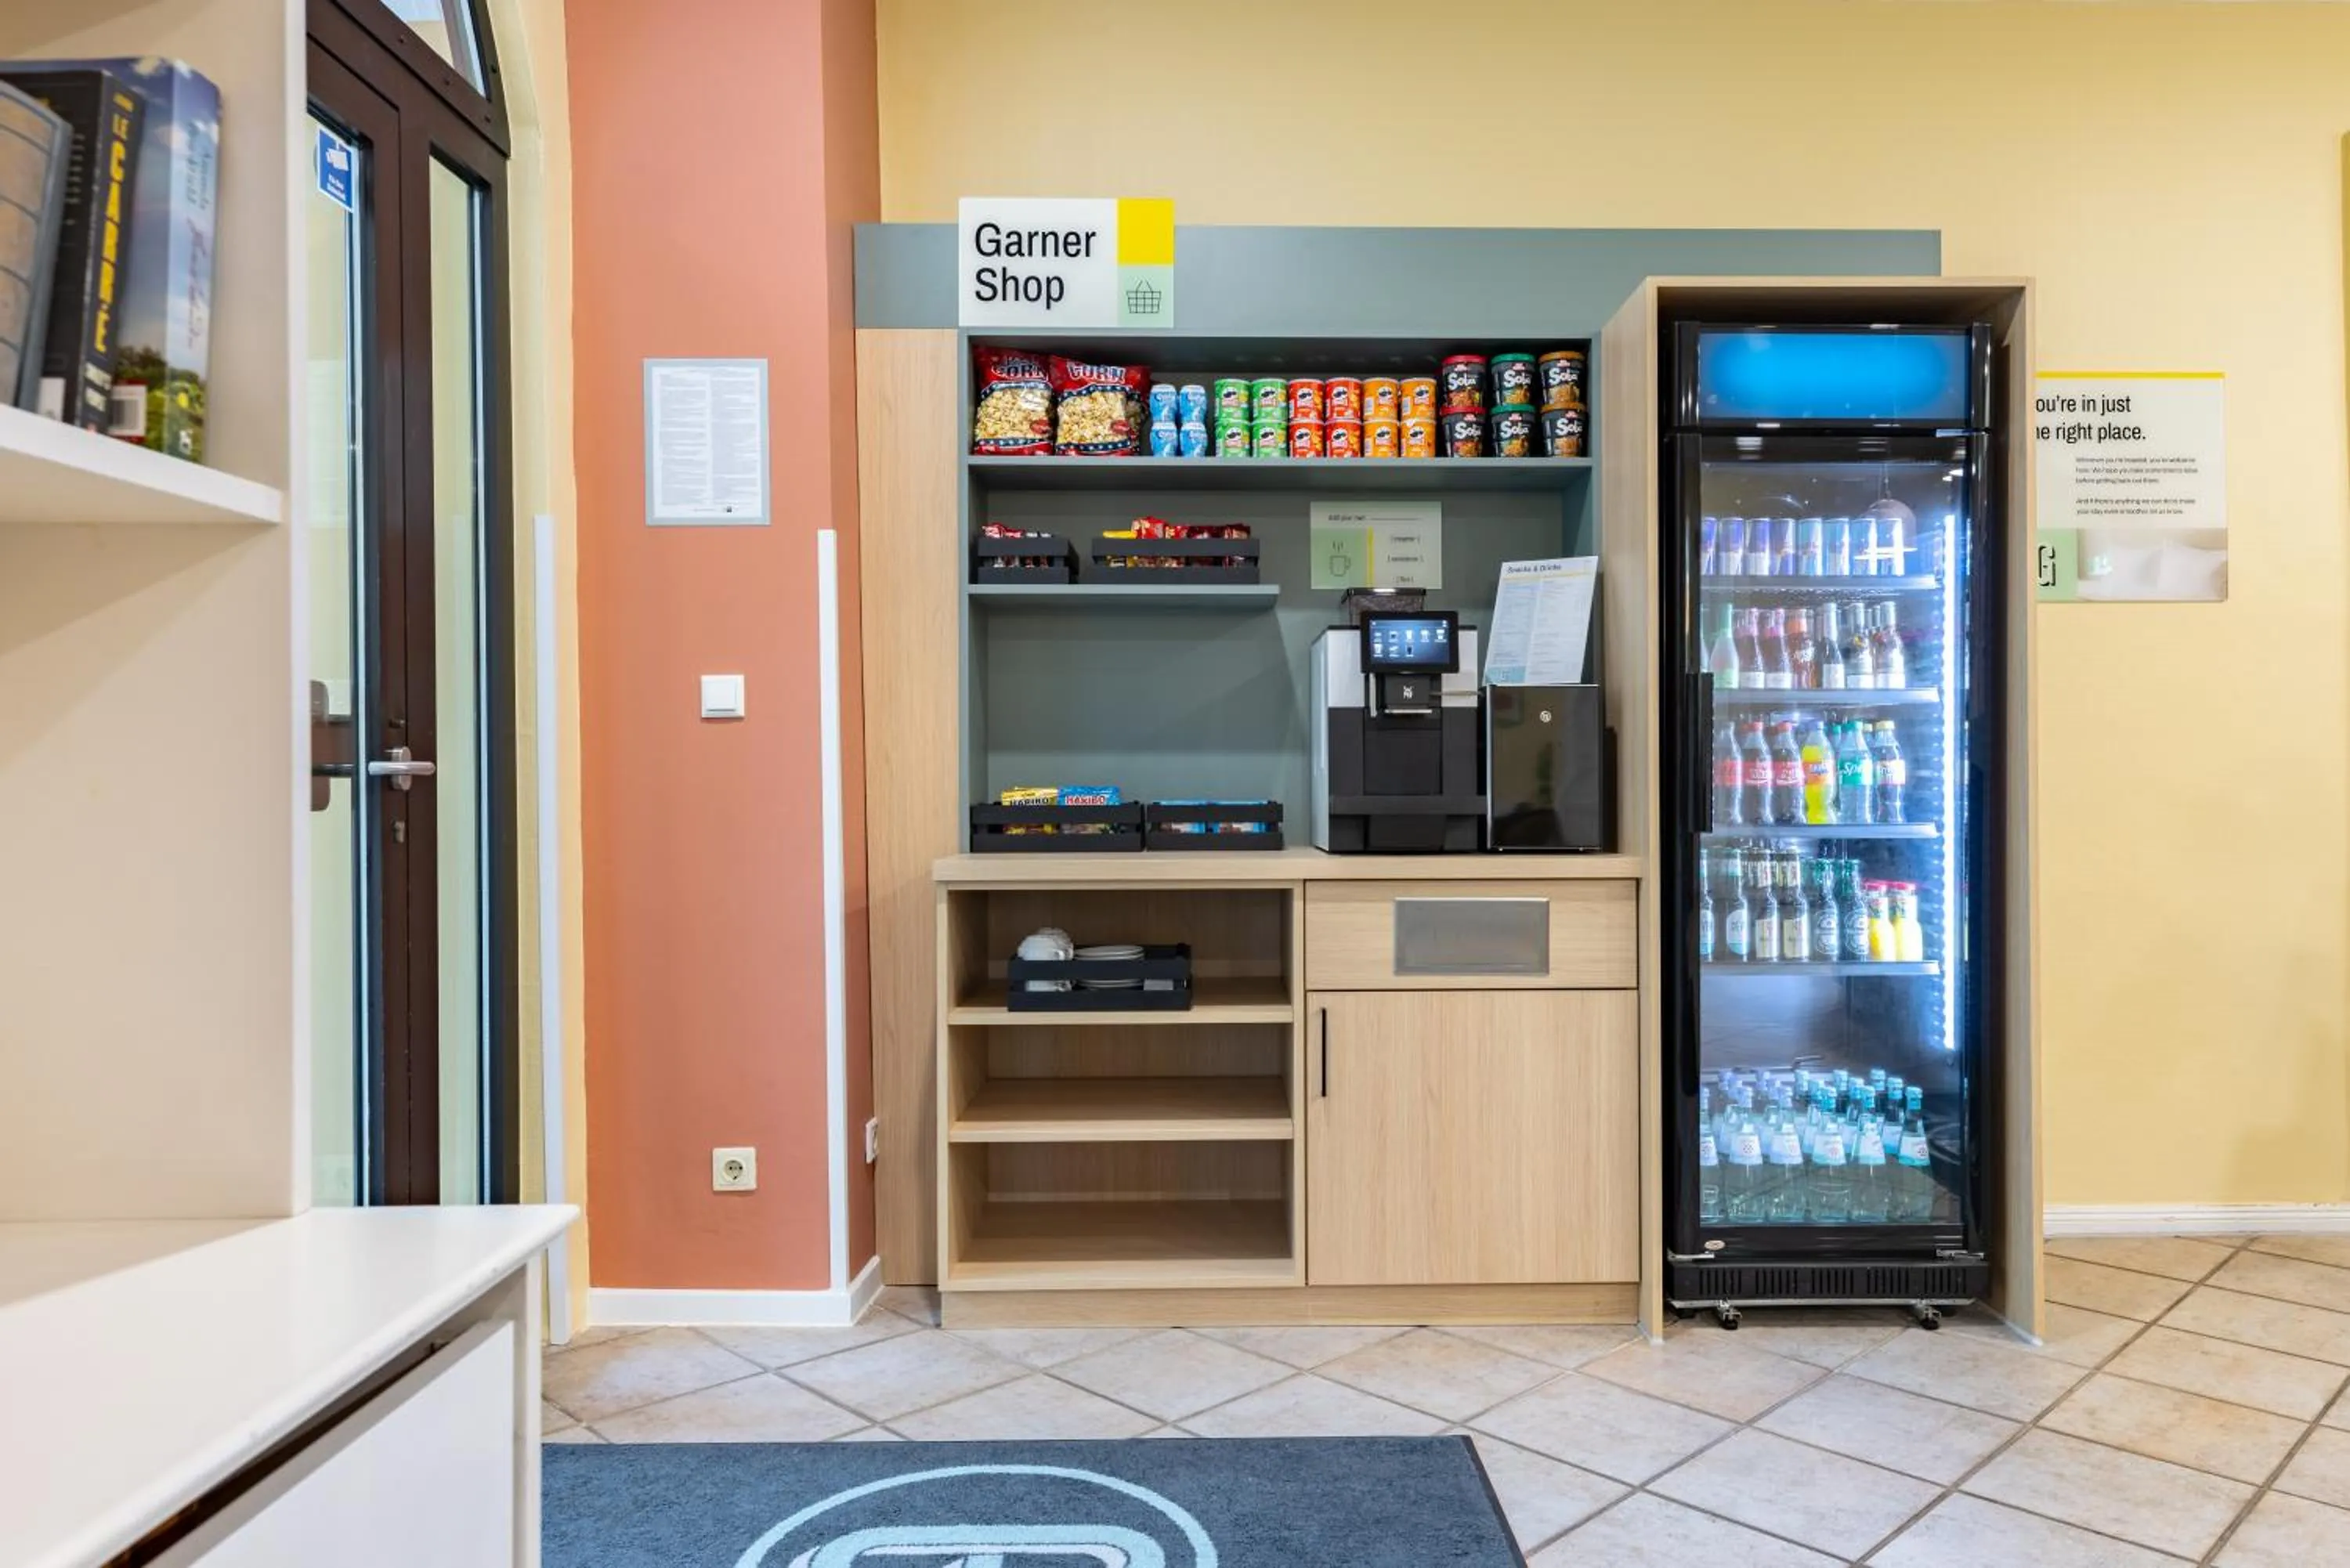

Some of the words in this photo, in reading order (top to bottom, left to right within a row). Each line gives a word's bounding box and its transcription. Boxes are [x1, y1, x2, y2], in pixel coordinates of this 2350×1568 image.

[974, 222, 1097, 258] Garner
[974, 267, 1065, 310] Shop
[2036, 395, 2077, 413] ou're
[2082, 394, 2096, 413] in
[2100, 394, 2131, 416] just
[2056, 422, 2093, 444] right
[2098, 422, 2146, 444] place.
